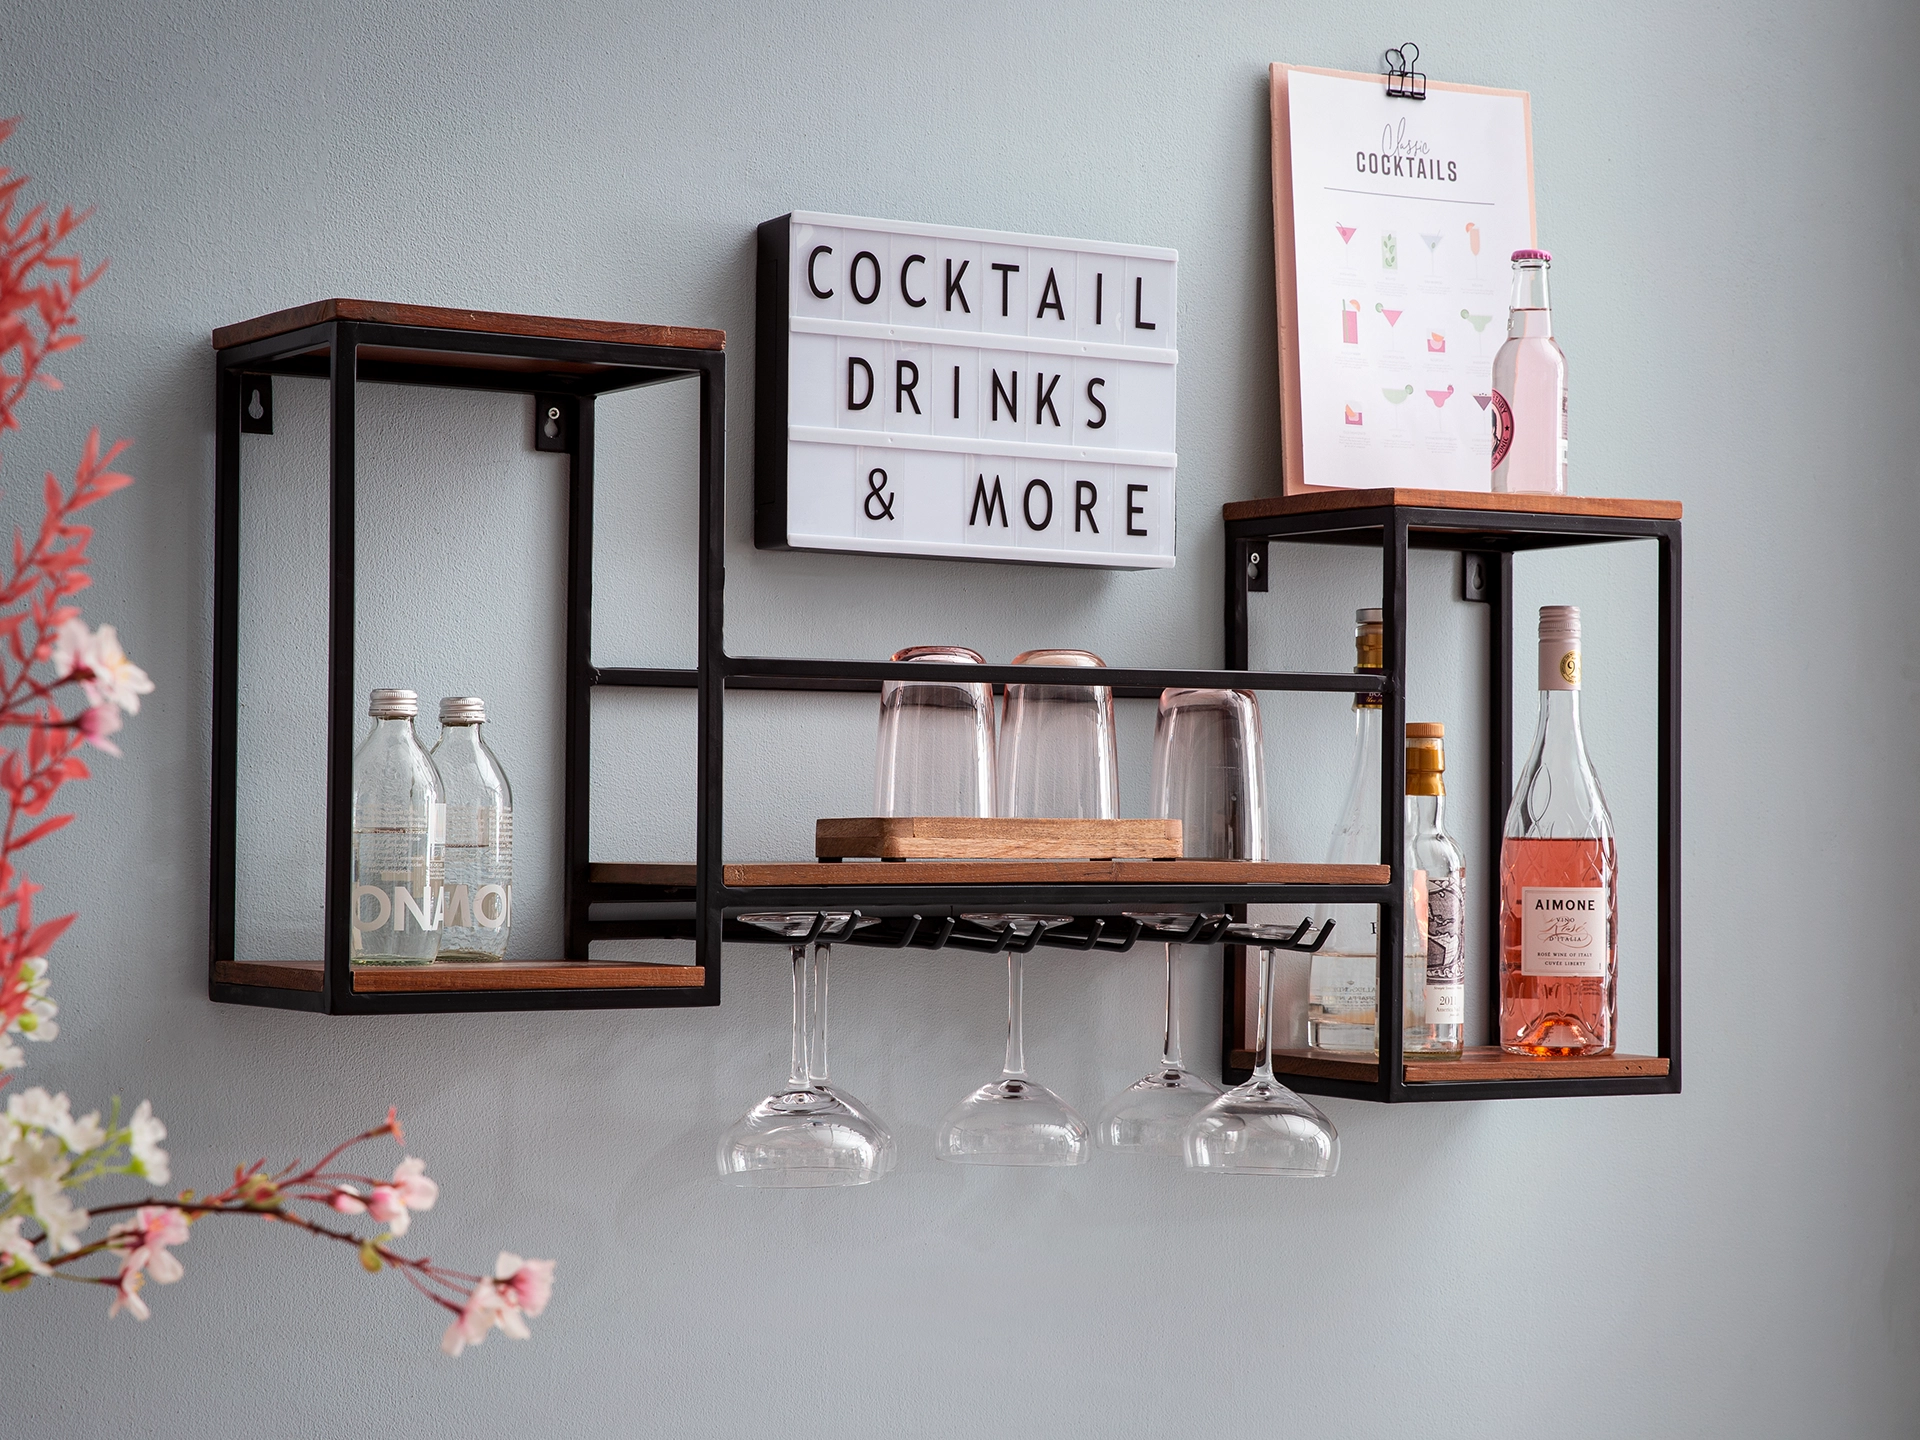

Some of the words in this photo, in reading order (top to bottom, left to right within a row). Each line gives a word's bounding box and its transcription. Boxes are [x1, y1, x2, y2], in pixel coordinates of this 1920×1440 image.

[1381, 117, 1430, 157] Classic
[1356, 151, 1457, 182] COCKTAILS
[807, 245, 1156, 330] COCKTAIL
[848, 356, 1107, 429] DRINKS
[864, 467, 895, 521] &
[969, 473, 1149, 537] MORE
[1535, 899, 1595, 911] AIMONE
